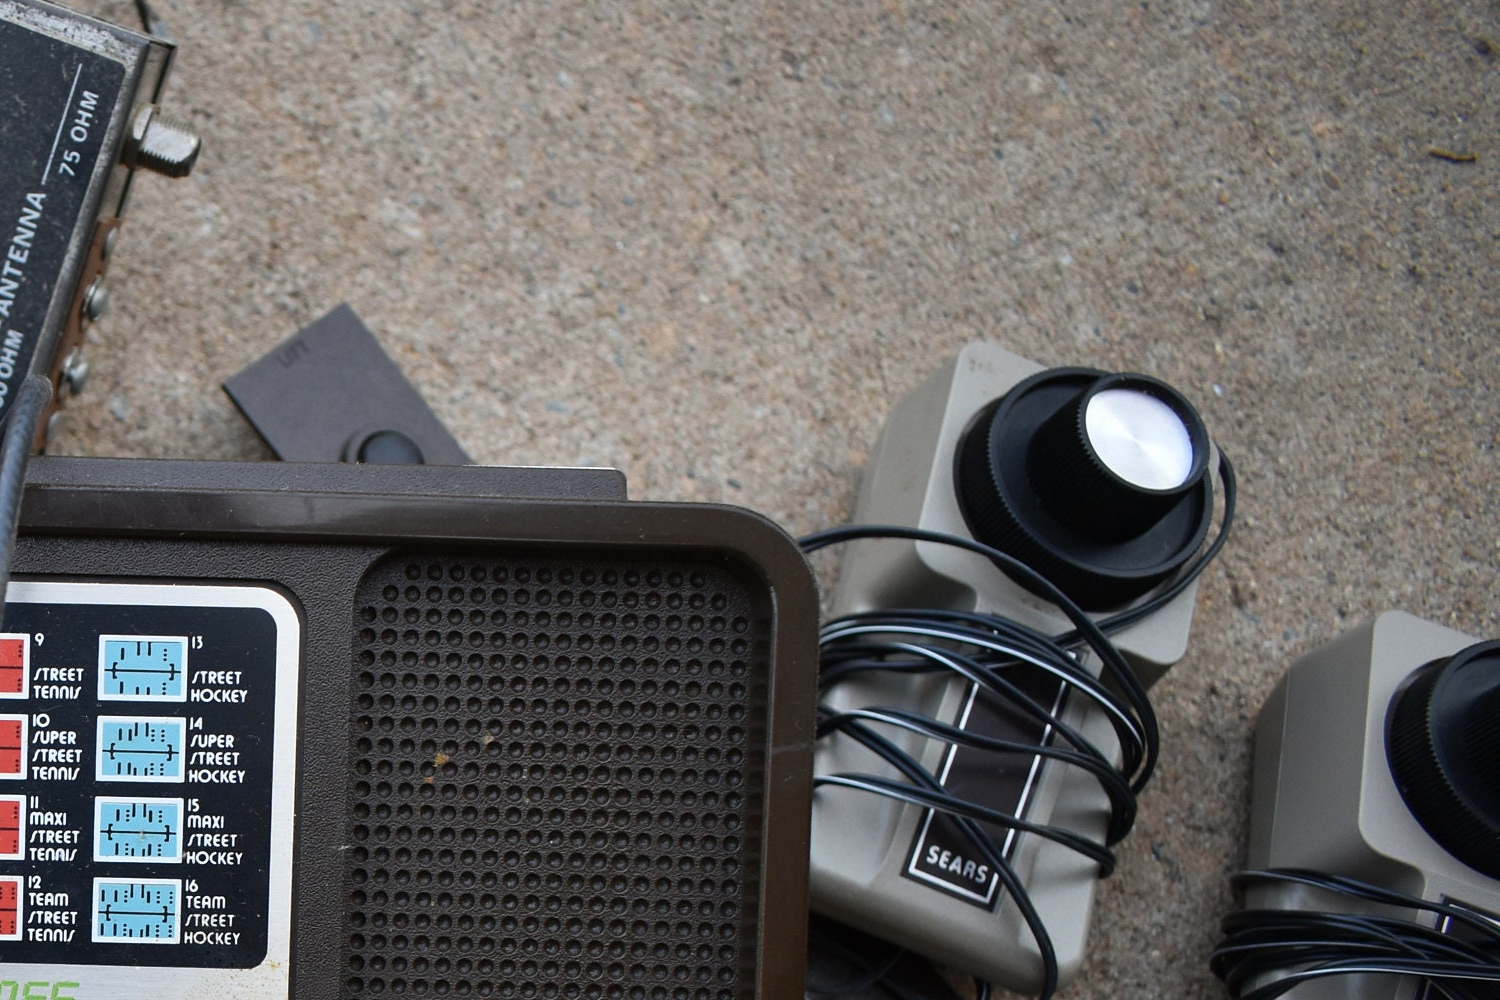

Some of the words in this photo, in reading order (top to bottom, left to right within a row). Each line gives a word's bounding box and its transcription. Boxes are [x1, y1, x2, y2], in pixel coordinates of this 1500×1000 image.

[58, 150, 81, 177] 75
[70, 90, 100, 143] OHM
[34, 633, 44, 646] 9
[191, 636, 203, 649] 13
[34, 668, 84, 681] STREET
[192, 671, 241, 684] STREET
[34, 685, 81, 699] TENNIS
[191, 689, 247, 702] HOCKEY
[32, 714, 50, 727] 10
[189, 717, 202, 730] 14
[33, 731, 76, 744] SUPER
[190, 735, 234, 748] SUPER
[32, 749, 82, 762] STREET
[190, 752, 239, 765] STREET
[32, 767, 80, 780] TENNIS
[189, 769, 245, 783] HOCKEY
[30, 796, 38, 808] 11
[187, 799, 199, 812] 15
[30, 812, 66, 825] MAXI
[188, 815, 224, 828] MAXI
[30, 830, 79, 843] STREET
[188, 834, 237, 847] STREET
[30, 848, 77, 861] TENNIS
[187, 851, 242, 865] HOCKEY
[926, 845, 988, 884] SEARS
[28, 876, 41, 888] 12
[185, 879, 198, 892] 16
[29, 893, 68, 906] TEAM
[186, 896, 225, 908] TEAM
[28, 911, 77, 924] STREET
[185, 914, 234, 927] STREET
[28, 928, 75, 942] TENNIS
[184, 931, 240, 945] HOCKEY
